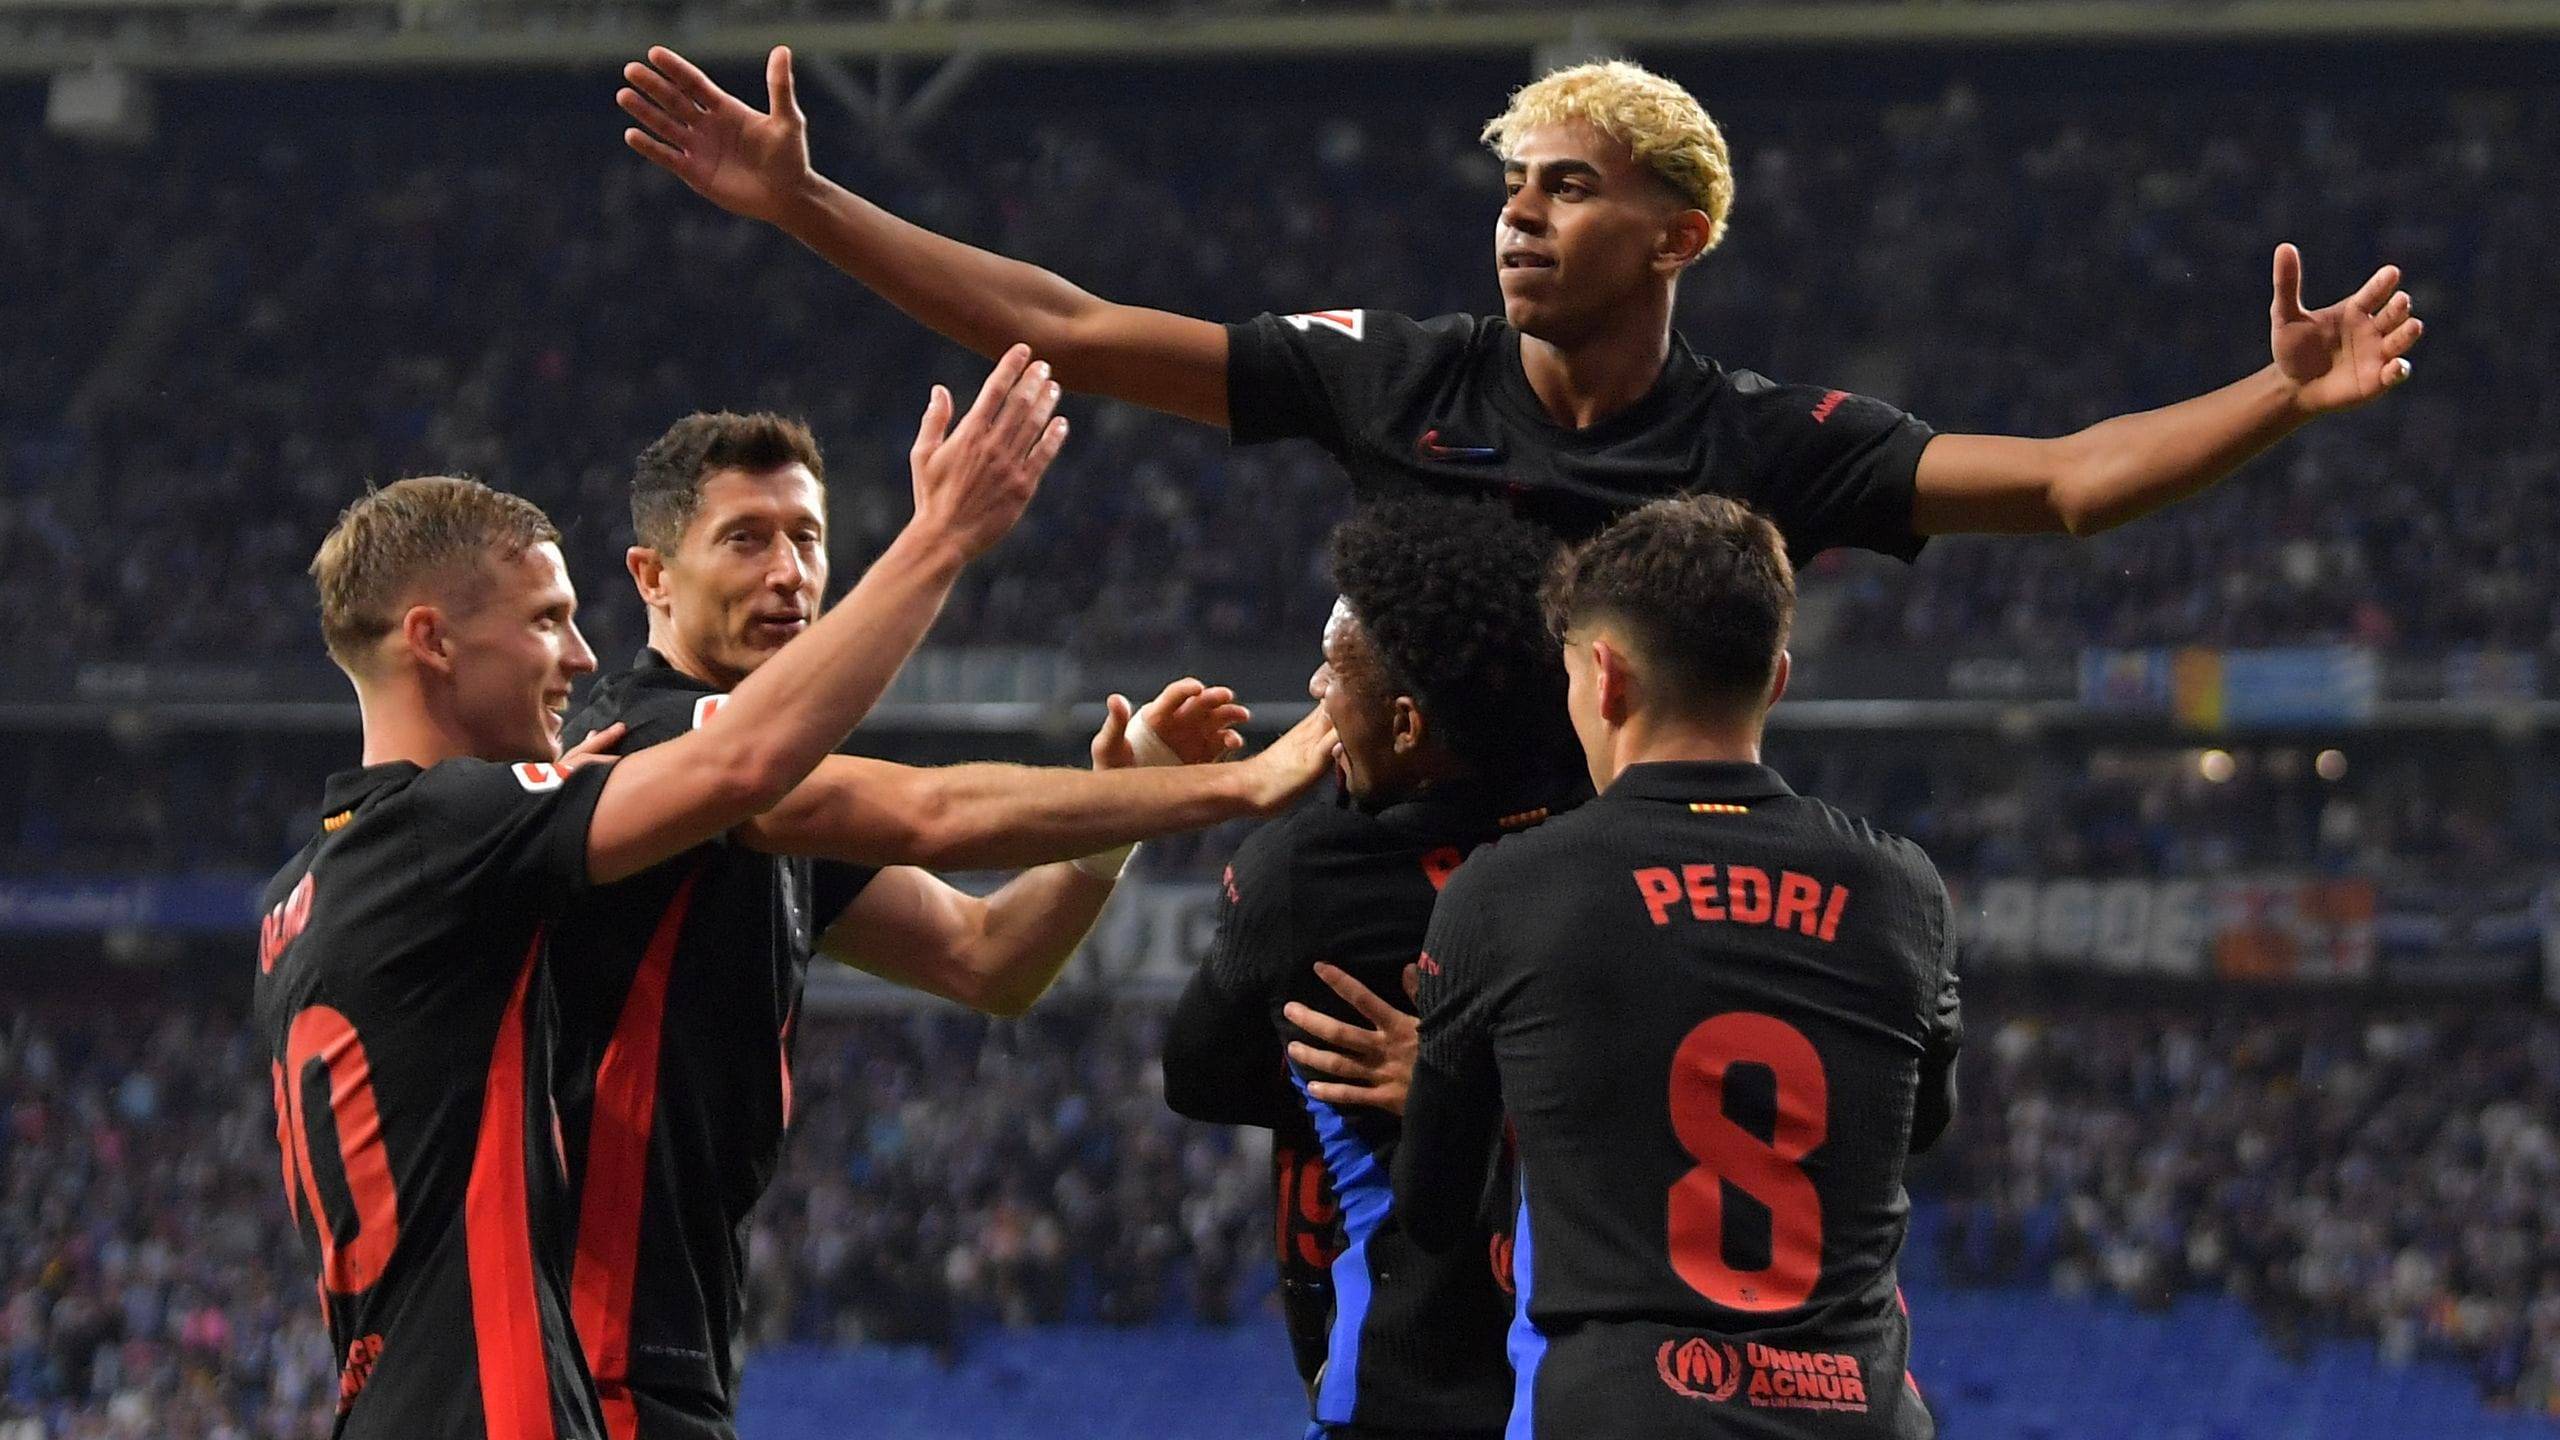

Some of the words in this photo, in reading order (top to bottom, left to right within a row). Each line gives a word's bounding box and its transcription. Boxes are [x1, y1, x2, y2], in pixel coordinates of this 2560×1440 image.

[1633, 863, 1849, 942] PEDRI
[1667, 1011, 1828, 1312] 8
[1747, 1342, 1860, 1378] UNHCR
[1750, 1369, 1866, 1402] ACNUR
